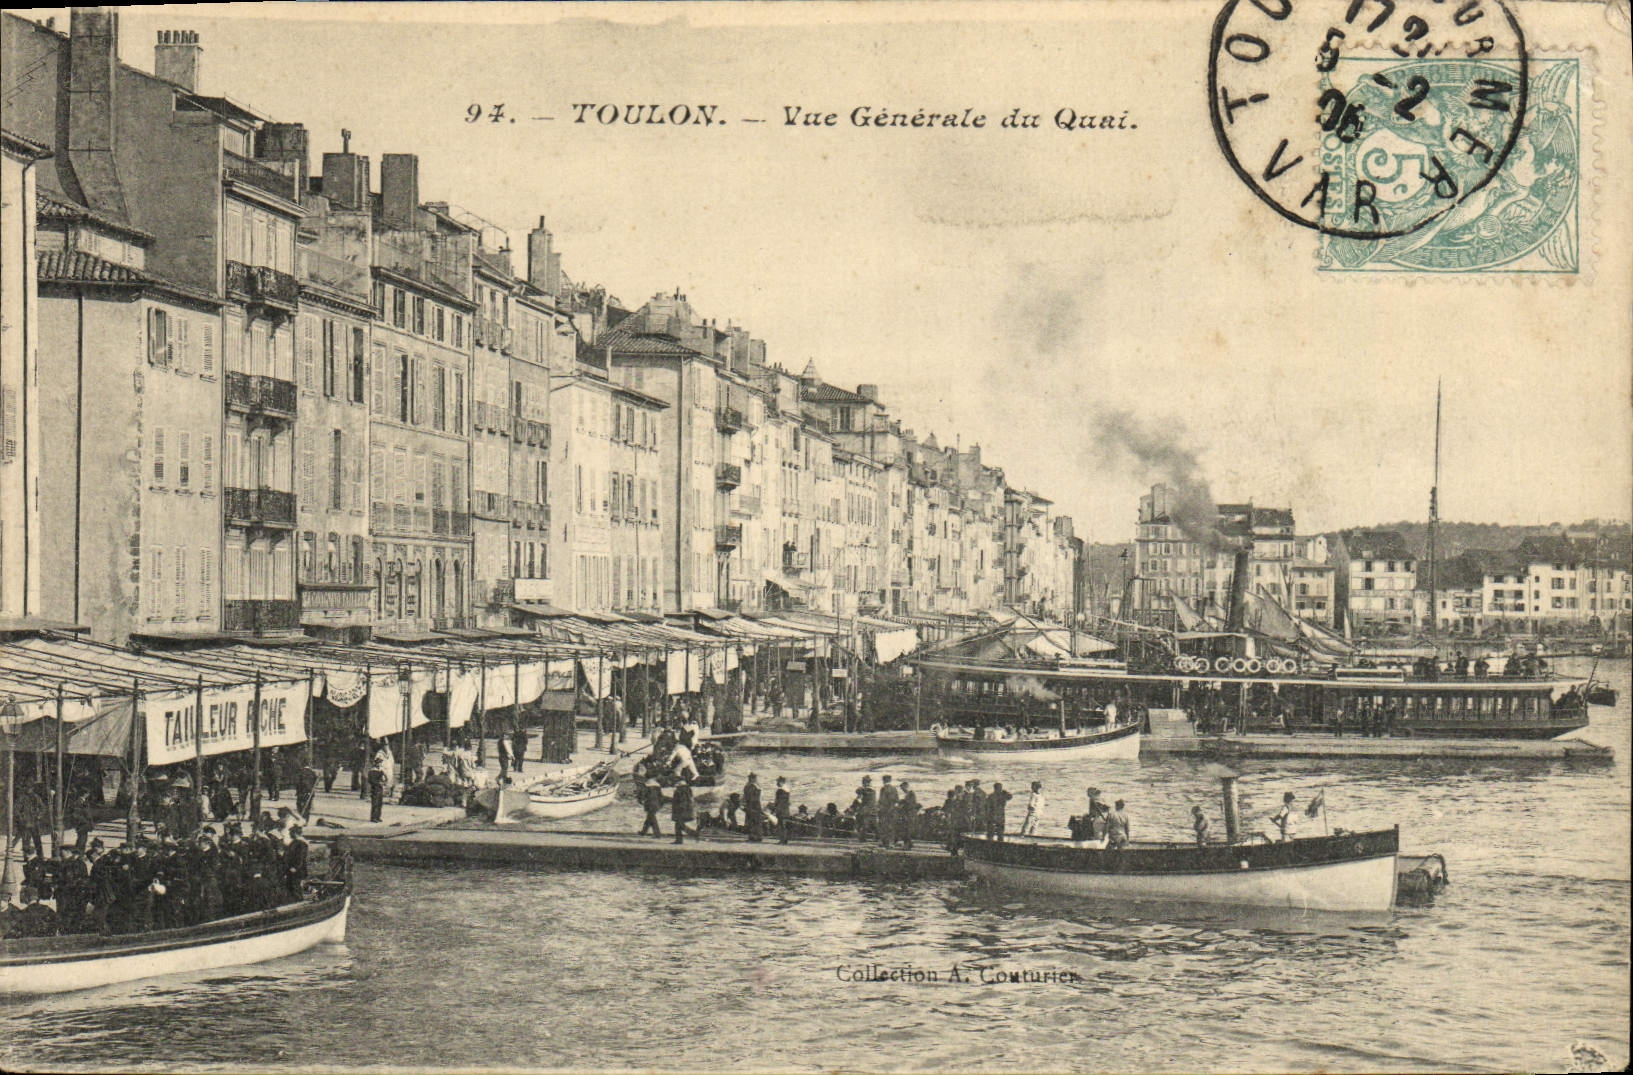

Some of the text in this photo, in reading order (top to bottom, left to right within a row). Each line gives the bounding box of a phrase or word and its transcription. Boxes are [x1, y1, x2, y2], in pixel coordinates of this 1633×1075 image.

[1433, 0, 1495, 57] UR
[1263, 139, 1380, 225] VAR
[1321, 120, 1345, 210] OSTES
[1420, 79, 1513, 199] MER
[165, 697, 287, 746] TAILLEUR RCHE
